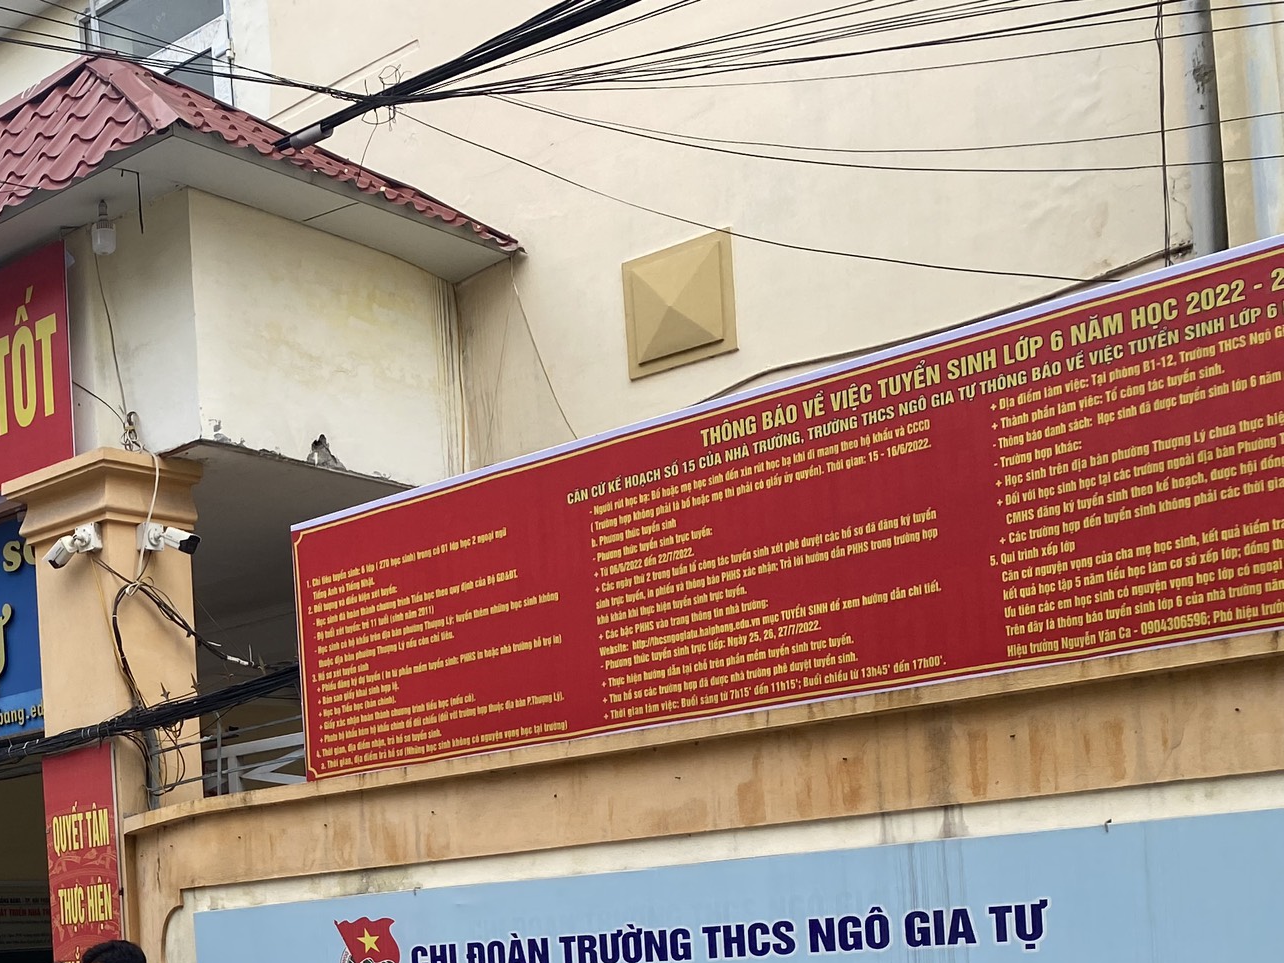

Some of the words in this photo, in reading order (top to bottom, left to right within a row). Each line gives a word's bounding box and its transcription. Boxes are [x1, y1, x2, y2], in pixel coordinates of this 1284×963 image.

[699, 415, 757, 447] THÔNG
[761, 403, 797, 430] BÁO
[801, 389, 825, 419] VỀ
[829, 382, 872, 411] VIỆC
[876, 359, 940, 398] TUYỂN
[946, 347, 997, 380] SINH
[1002, 335, 1043, 365] LỚP
[1049, 329, 1063, 351] 6
[1069, 311, 1123, 346] NĂM
[1130, 297, 1178, 330] HỌC
[1185, 278, 1245, 315] 2022
[566, 487, 588, 504] CĂN
[590, 480, 606, 497] CỨ
[607, 474, 622, 493] KẾ
[623, 467, 661, 489] HOẠCH
[663, 459, 679, 478] SỐ
[681, 458, 695, 473] 15
[698, 450, 722, 469] CỦA
[724, 442, 749, 462] NHÀ
[751, 430, 804, 454] TRƯỜNG,
[806, 415, 858, 440] TRƯỜNG
[860, 405, 895, 426] THCS
[898, 394, 926, 416] NGÔ
[930, 389, 954, 407] GIA
[957, 381, 976, 401] TỰ
[978, 369, 1027, 395] THÔNG
[1031, 360, 1061, 381] BÁO
[1065, 349, 1085, 372] VỀ
[1088, 343, 1123, 365] VIỆC
[1127, 326, 1179, 355] TUYỂN
[1184, 316, 1224, 340] SINH
[1229, 307, 1261, 329] LỚP
[1266, 302, 1277, 318] 6
[989, 554, 998, 566] 5.
[1000, 550, 1015, 565] Qui
[1017, 546, 1039, 561] trình
[1040, 541, 1058, 557] xếp
[1059, 539, 1075, 553] lớp
[1006, 643, 1027, 658] Hiệu
[1029, 638, 1059, 654] trưởng
[1060, 630, 1096, 649] Nguyễn
[1097, 628, 1116, 643] Văn
[1118, 626, 1131, 639] Ca
[1140, 611, 1210, 635] 0904306596;
[1212, 607, 1233, 623] Phó
[1235, 604, 1258, 620] hiệu
[52, 801, 84, 856] QUYẾT
[86, 802, 110, 848] TÂM
[58, 884, 85, 933] THỰC
[87, 876, 112, 930] HIỆN
[702, 920, 796, 959] THCS
[808, 906, 890, 953] NGÔ
[904, 908, 977, 948] GIA
[988, 899, 1048, 950] TỰ
